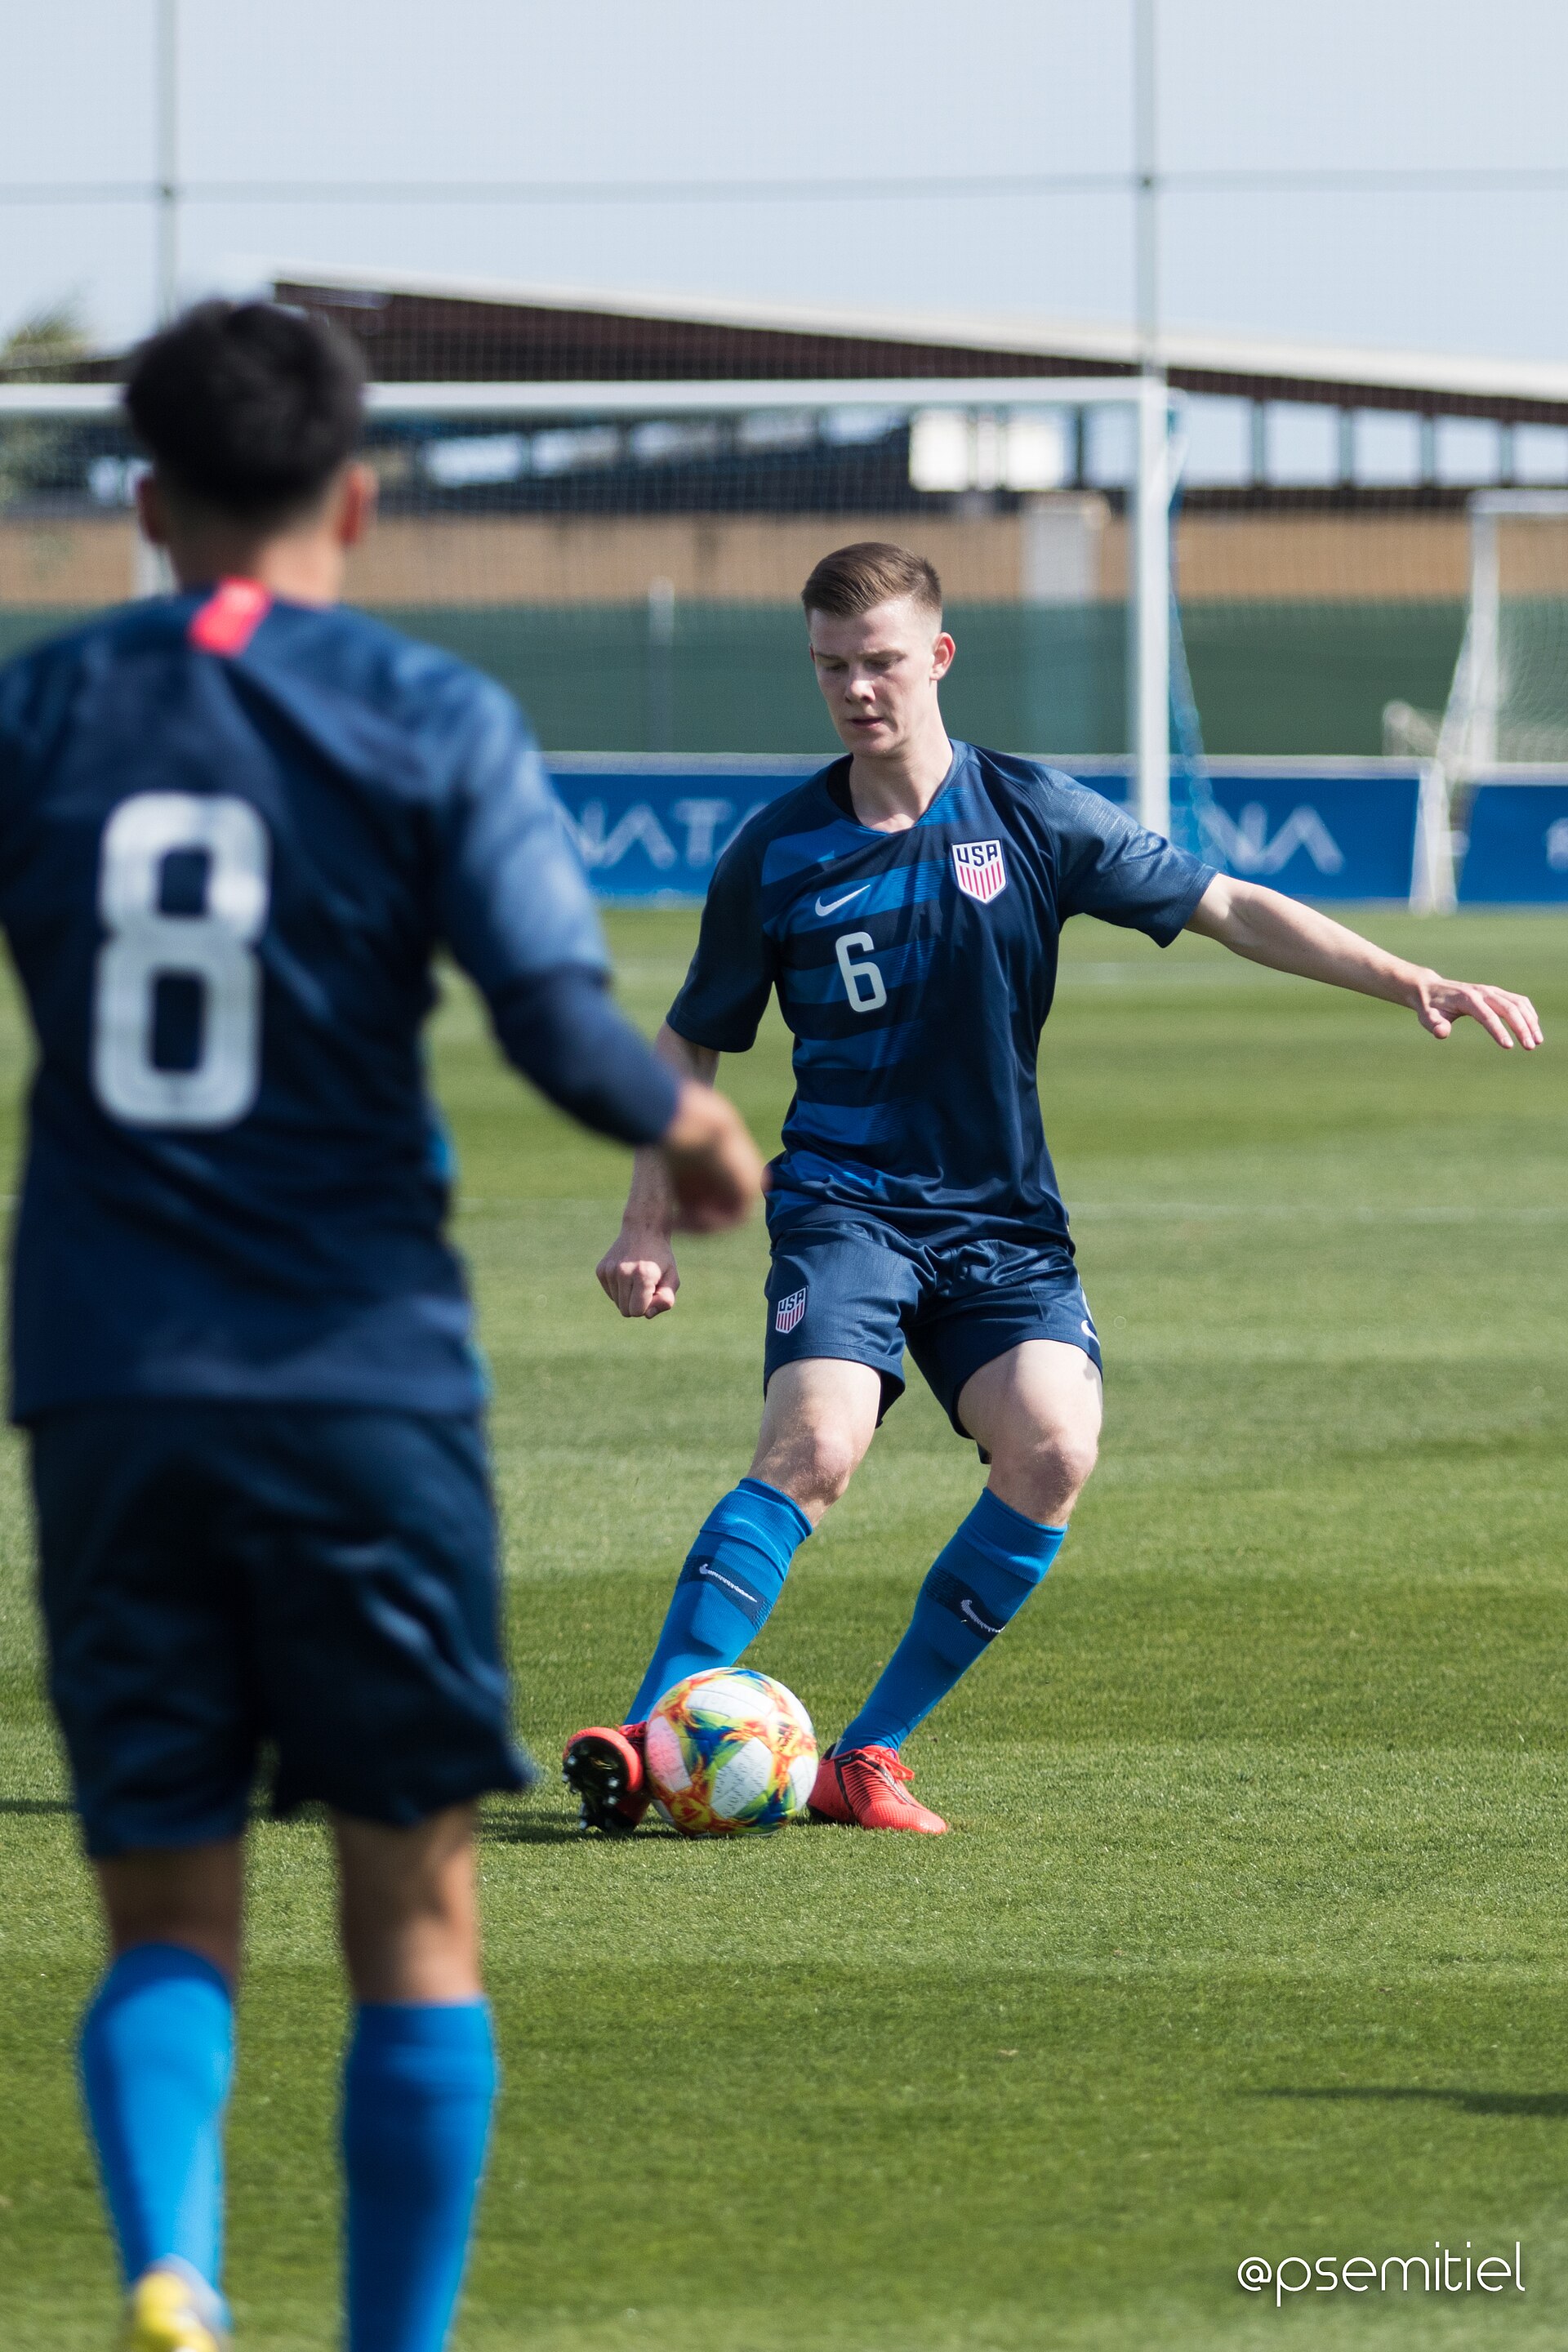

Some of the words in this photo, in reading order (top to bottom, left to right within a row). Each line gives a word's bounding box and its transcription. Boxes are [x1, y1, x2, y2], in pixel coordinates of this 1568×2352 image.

[557, 795, 768, 871] NAT
[956, 844, 999, 867] USA
[95, 791, 270, 1130] 8
[835, 931, 888, 1013] 6
[778, 1290, 805, 1312] USA
